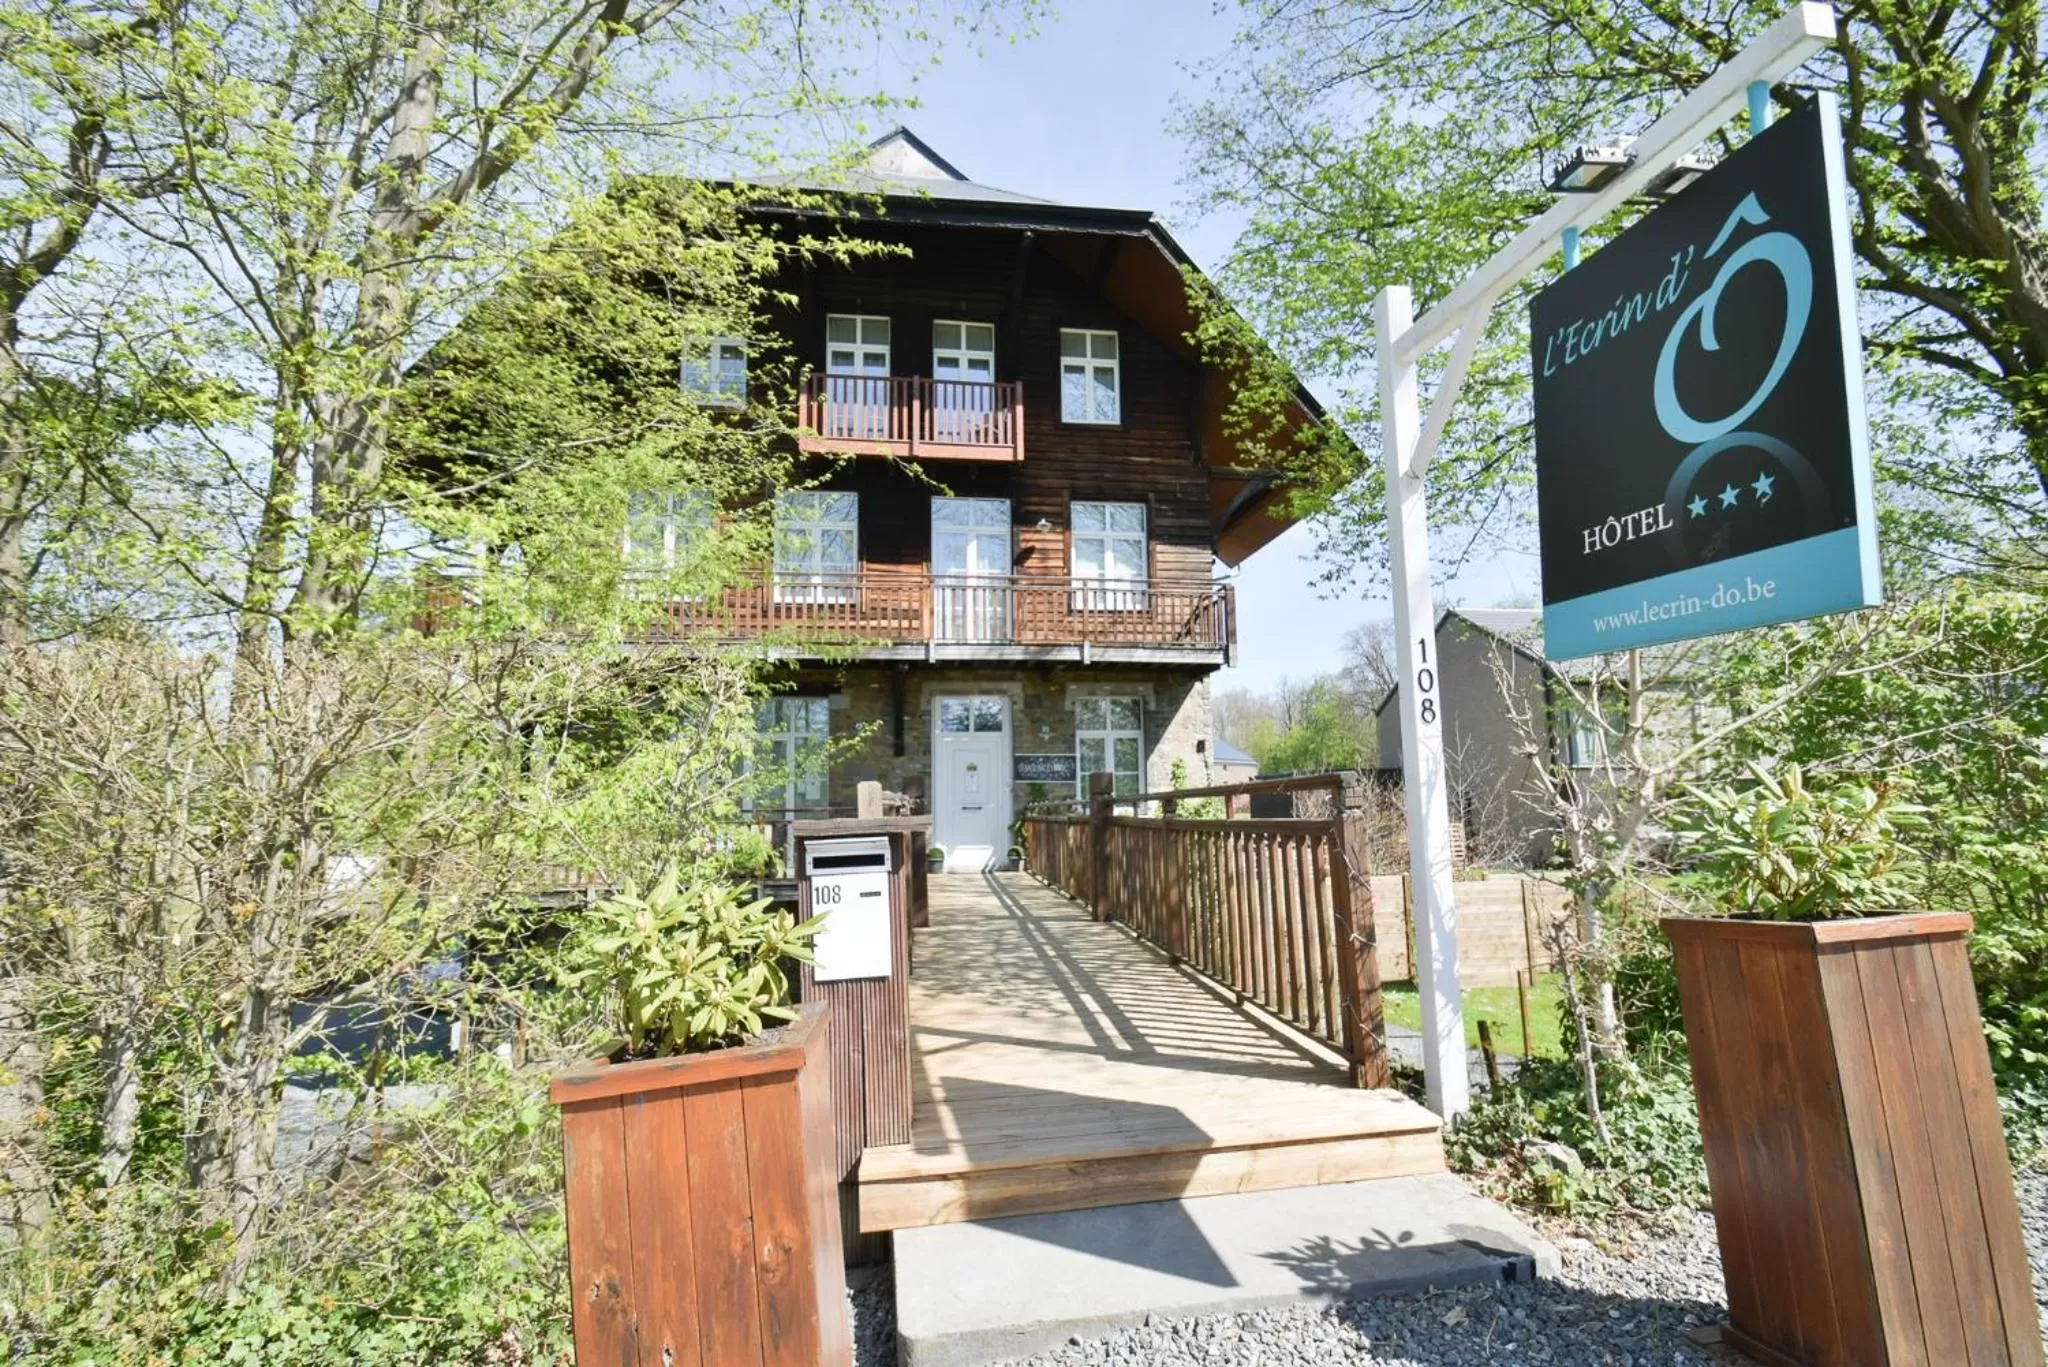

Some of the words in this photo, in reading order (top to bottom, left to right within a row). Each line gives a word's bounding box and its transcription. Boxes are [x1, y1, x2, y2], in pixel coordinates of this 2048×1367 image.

[1582, 503, 1674, 554] HÔTEL
[1593, 576, 1776, 633] www.lecrin-do.be
[1417, 637, 1436, 724] 108
[814, 884, 842, 906] 108
